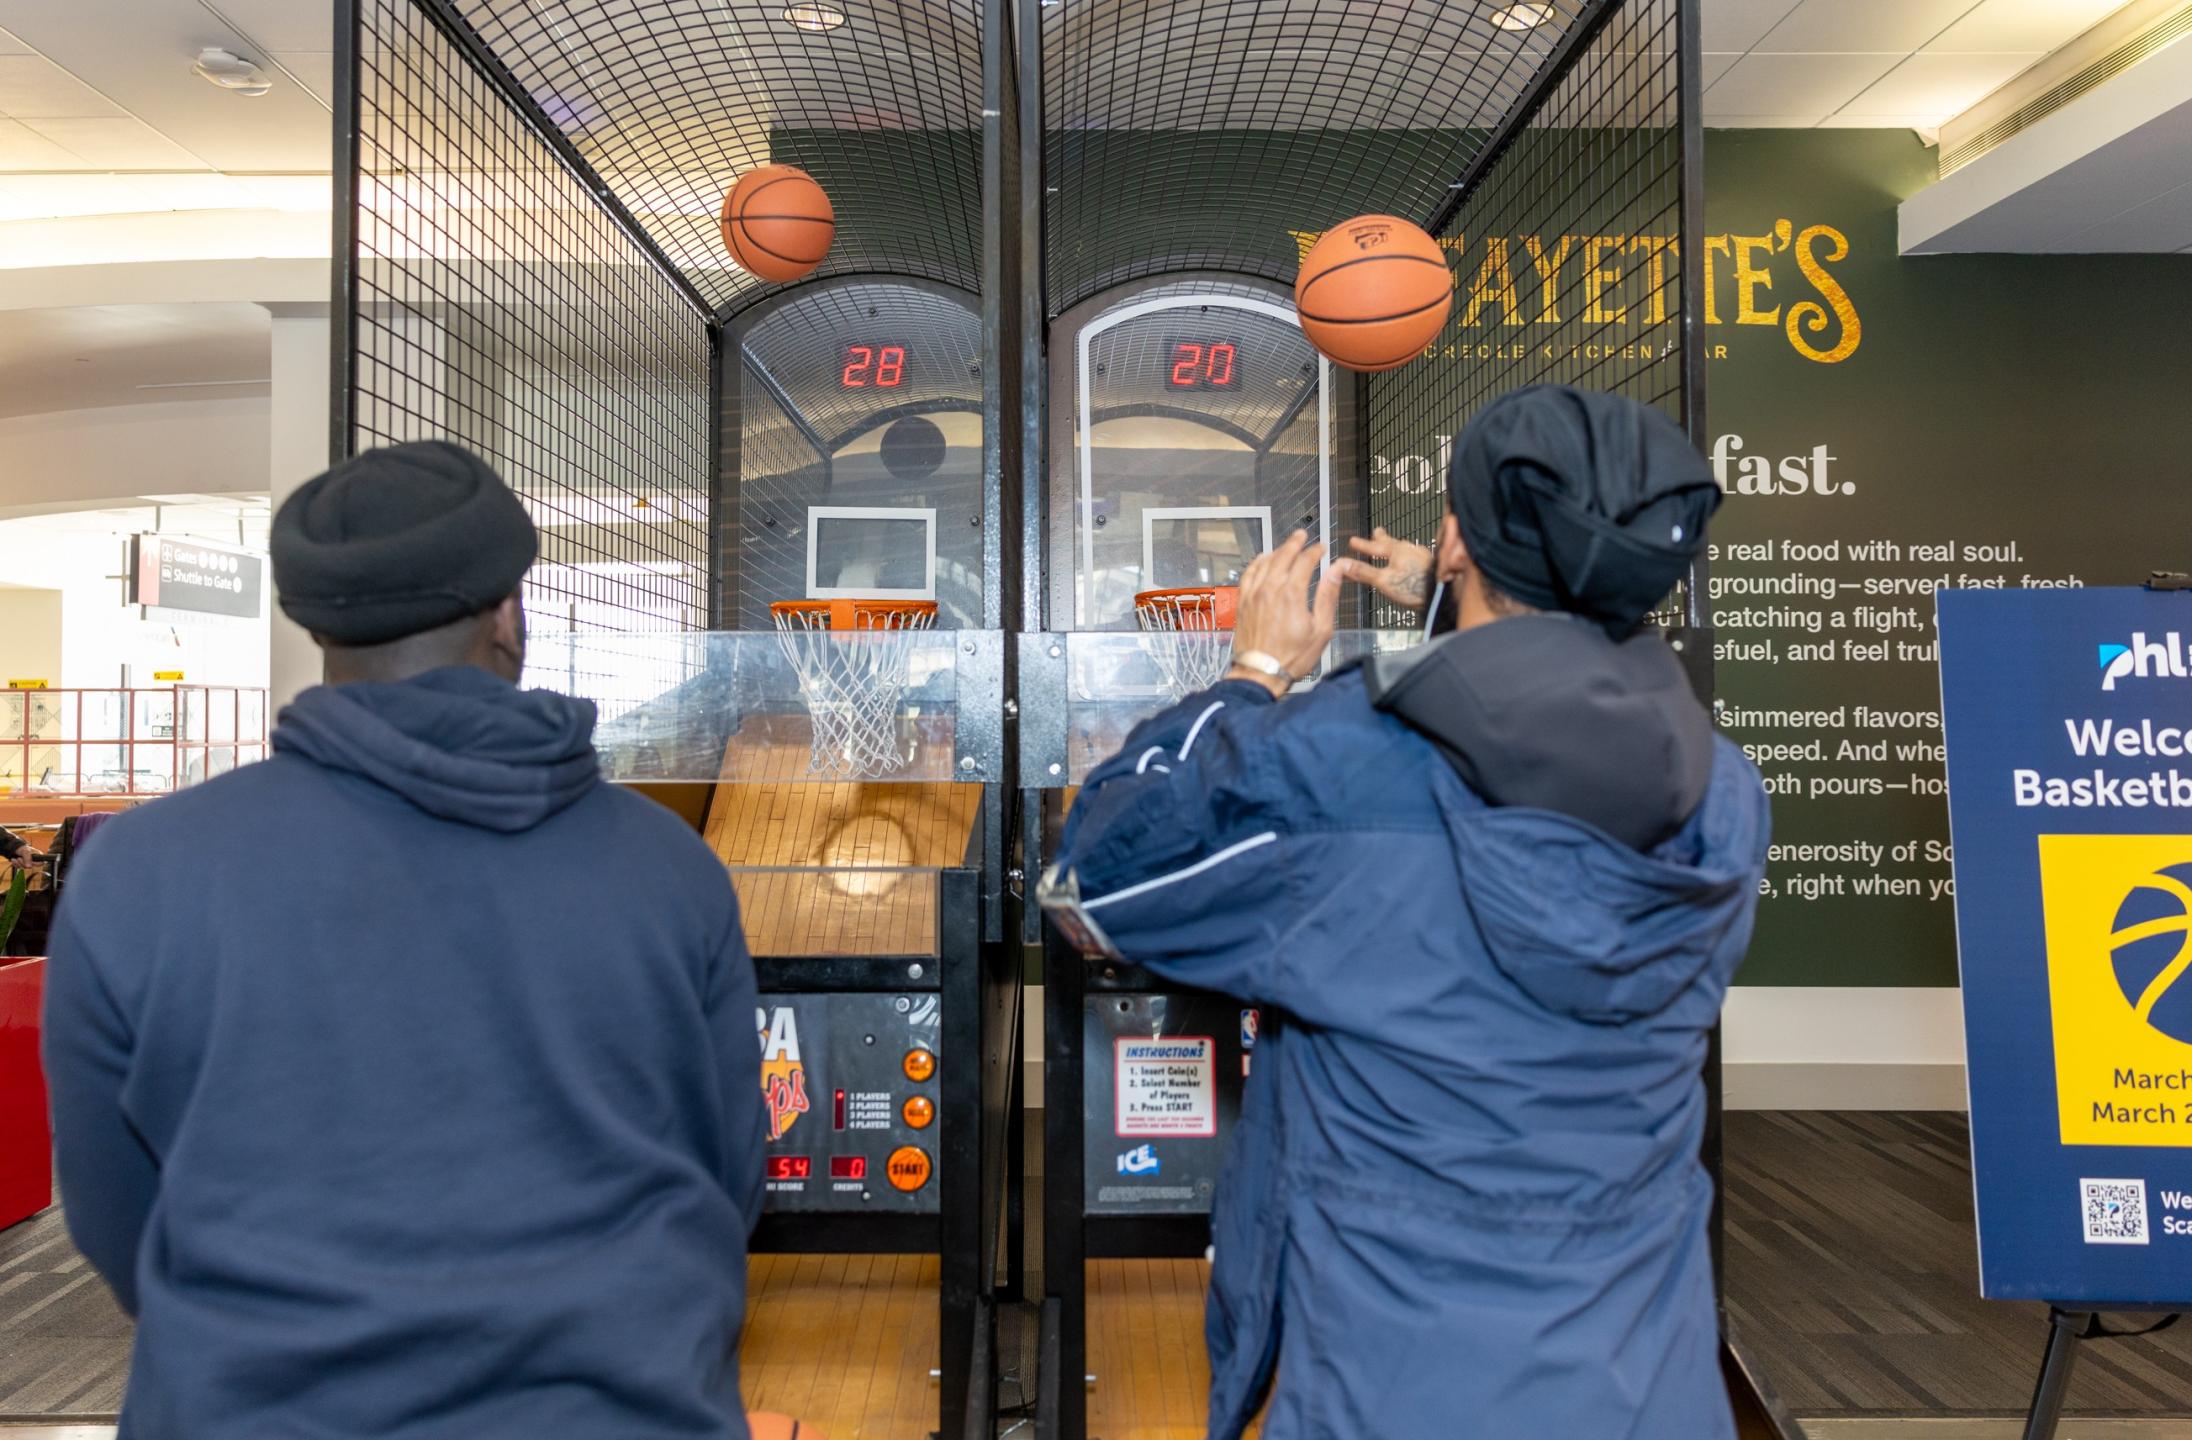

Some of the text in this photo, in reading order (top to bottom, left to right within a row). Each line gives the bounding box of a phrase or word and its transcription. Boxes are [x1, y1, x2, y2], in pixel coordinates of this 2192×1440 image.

[842, 347, 905, 386] 28
[1172, 344, 1234, 385] 20
[1708, 434, 1857, 497] fast.
[1728, 540, 1774, 561] real
[1781, 540, 1839, 562] food
[1847, 540, 1900, 562] with
[1908, 541, 1955, 562] real
[1962, 541, 2024, 562] soul.
[173, 569, 203, 586] Shuttle
[203, 575, 213, 588] to
[213, 576, 233, 591] Gate
[1712, 606, 1822, 633] catching
[1830, 611, 1846, 628] a
[1853, 606, 1925, 633] flight,
[1713, 639, 1938, 664] efuel, and feel trul
[1719, 706, 1845, 728] simmered
[1742, 739, 1947, 766] speed. And whe
[1762, 773, 1802, 795] oth
[2013, 769, 2192, 808] Basketb
[1767, 840, 1955, 867] enerosity of So
[1787, 873, 1845, 901] right
[1852, 873, 1921, 896] when
[1928, 878, 1956, 901] yo
[1126, 1046, 1204, 1059] INSTRUCTIONS
[1130, 1066, 1198, 1077] 1. Insert Coin(s)
[1130, 1079, 1201, 1088] 2. Select Number
[855, 1092, 891, 1101] PLAYERS
[855, 1101, 891, 1110] PLAYERS
[1130, 1102, 1193, 1112] 3. Press START
[1149, 1091, 1190, 1102] of Players
[855, 1111, 891, 1119] PLAYERS
[2092, 1101, 2176, 1124] March
[855, 1120, 891, 1129] PLAYERS
[850, 1158, 865, 1179] 0
[892, 1163, 924, 1175] START
[1117, 1144, 1159, 1173] ICE
[2160, 1191, 2192, 1210] We
